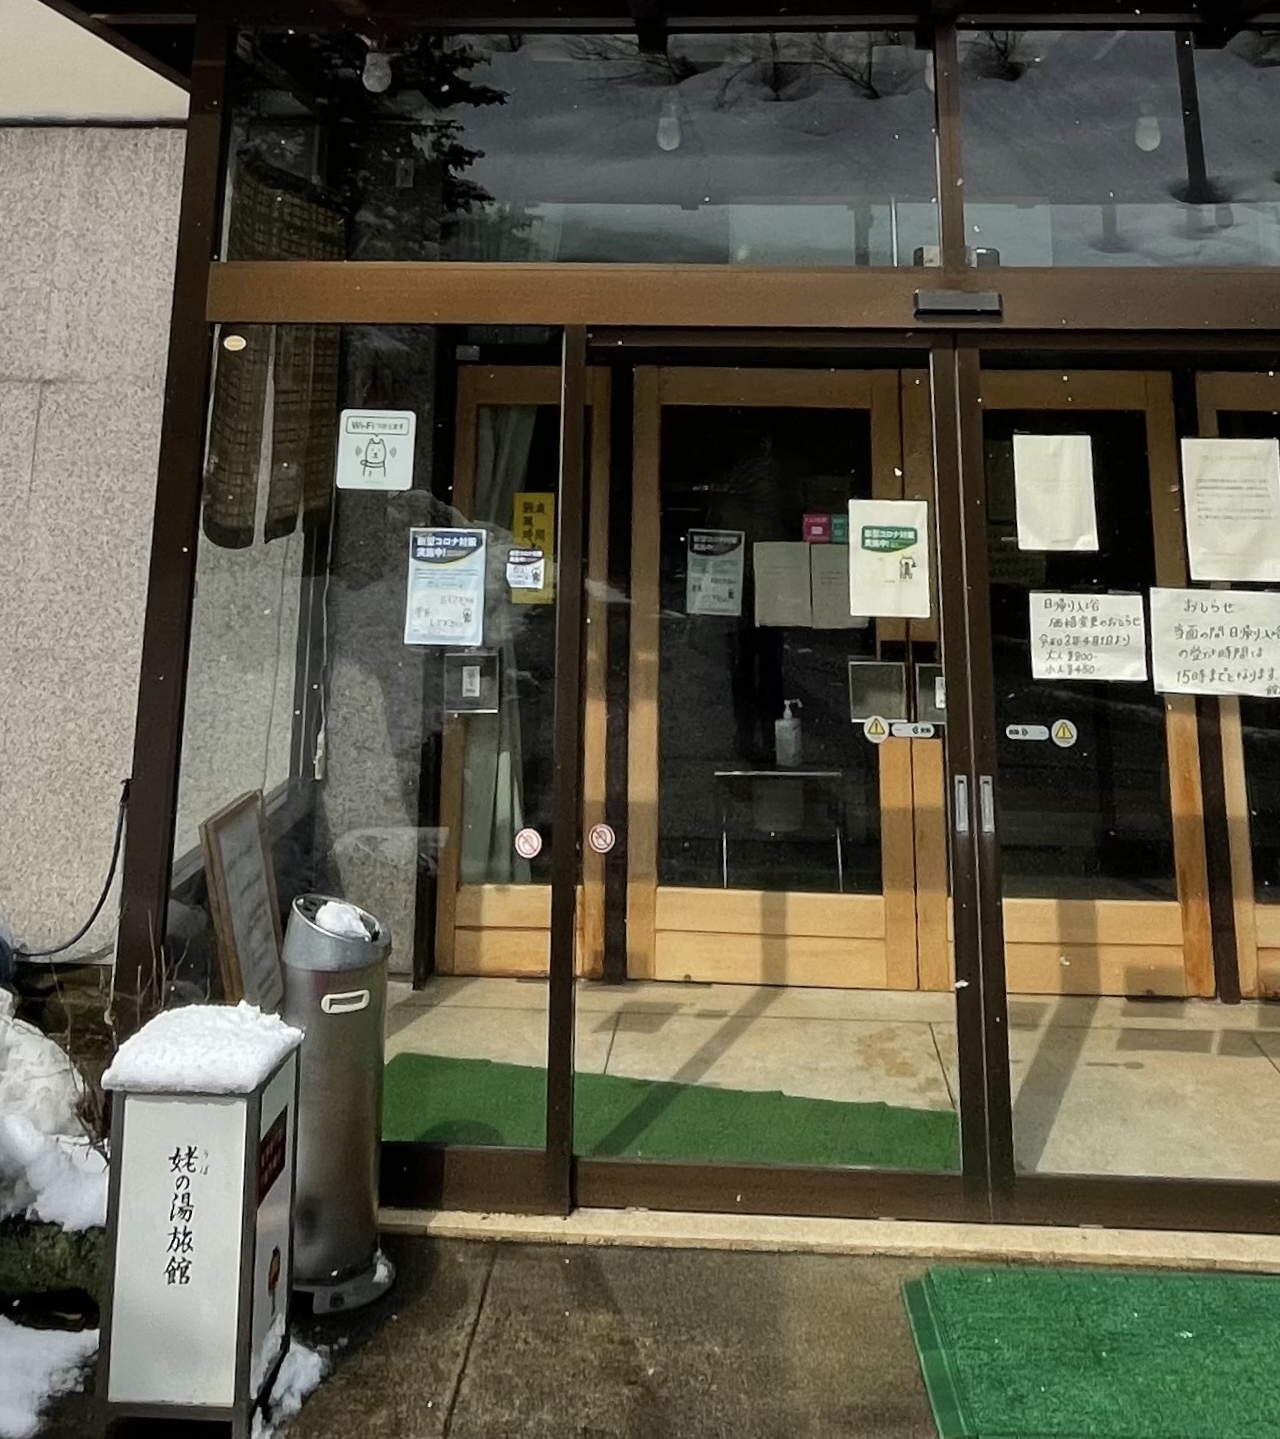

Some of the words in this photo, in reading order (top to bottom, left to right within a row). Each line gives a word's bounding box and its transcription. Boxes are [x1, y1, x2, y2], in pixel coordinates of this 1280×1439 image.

[351, 420, 375, 431] Wi-Fi
[1182, 597, 1235, 614] おしらせ
[163, 1145, 199, 1287] 姥の湯旅館
